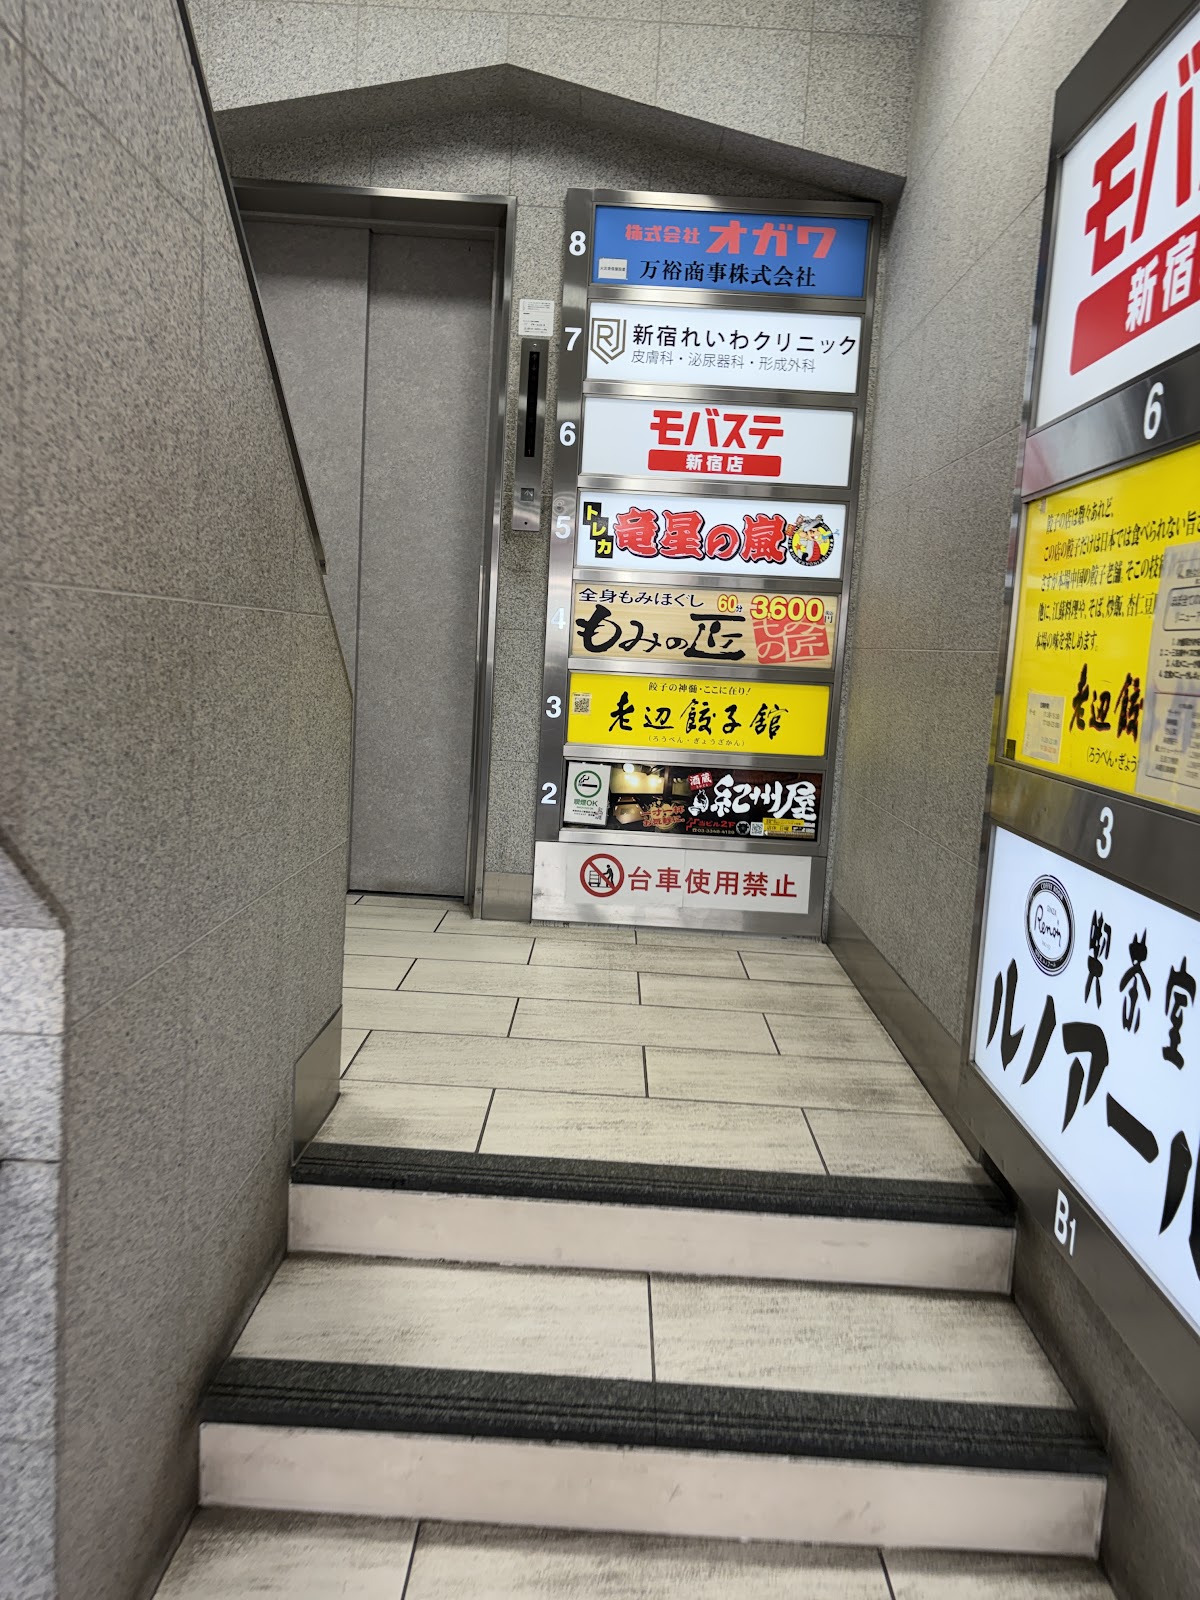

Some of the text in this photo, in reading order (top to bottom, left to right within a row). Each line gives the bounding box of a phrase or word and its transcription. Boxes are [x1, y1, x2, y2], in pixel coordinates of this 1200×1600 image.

[1084, 40, 1200, 277] モバ
[568, 231, 586, 256] 8
[625, 220, 838, 258] 株式会社 オガワ
[639, 260, 817, 288] 万裕商事株式会社
[1125, 230, 1200, 332] 新宿
[564, 327, 582, 351] 7
[632, 323, 857, 356] 新宿れいわクリニック
[630, 350, 816, 373] 皮膚科・泌尿器科・形成外科
[1143, 382, 1165, 440] 6
[559, 421, 576, 446] 6
[650, 408, 785, 450] モバステ
[685, 453, 744, 473] 新宿店
[555, 515, 571, 539] 5
[586, 504, 613, 556] トレカ
[613, 506, 788, 565] 竜星の嵐
[578, 587, 705, 607] 全身もみほぐし
[717, 594, 743, 613] 60分
[550, 608, 566, 629] 4
[575, 603, 747, 661] もみの匠
[545, 695, 562, 718] 3
[541, 783, 558, 804] 2
[690, 772, 712, 786] 酒蔵
[709, 774, 818, 821] 紀州屋
[1096, 805, 1114, 860] 3
[628, 866, 798, 898] 台車使用禁止
[1084, 909, 1198, 1070] 喫茶室
[1053, 1188, 1077, 1257] B1
